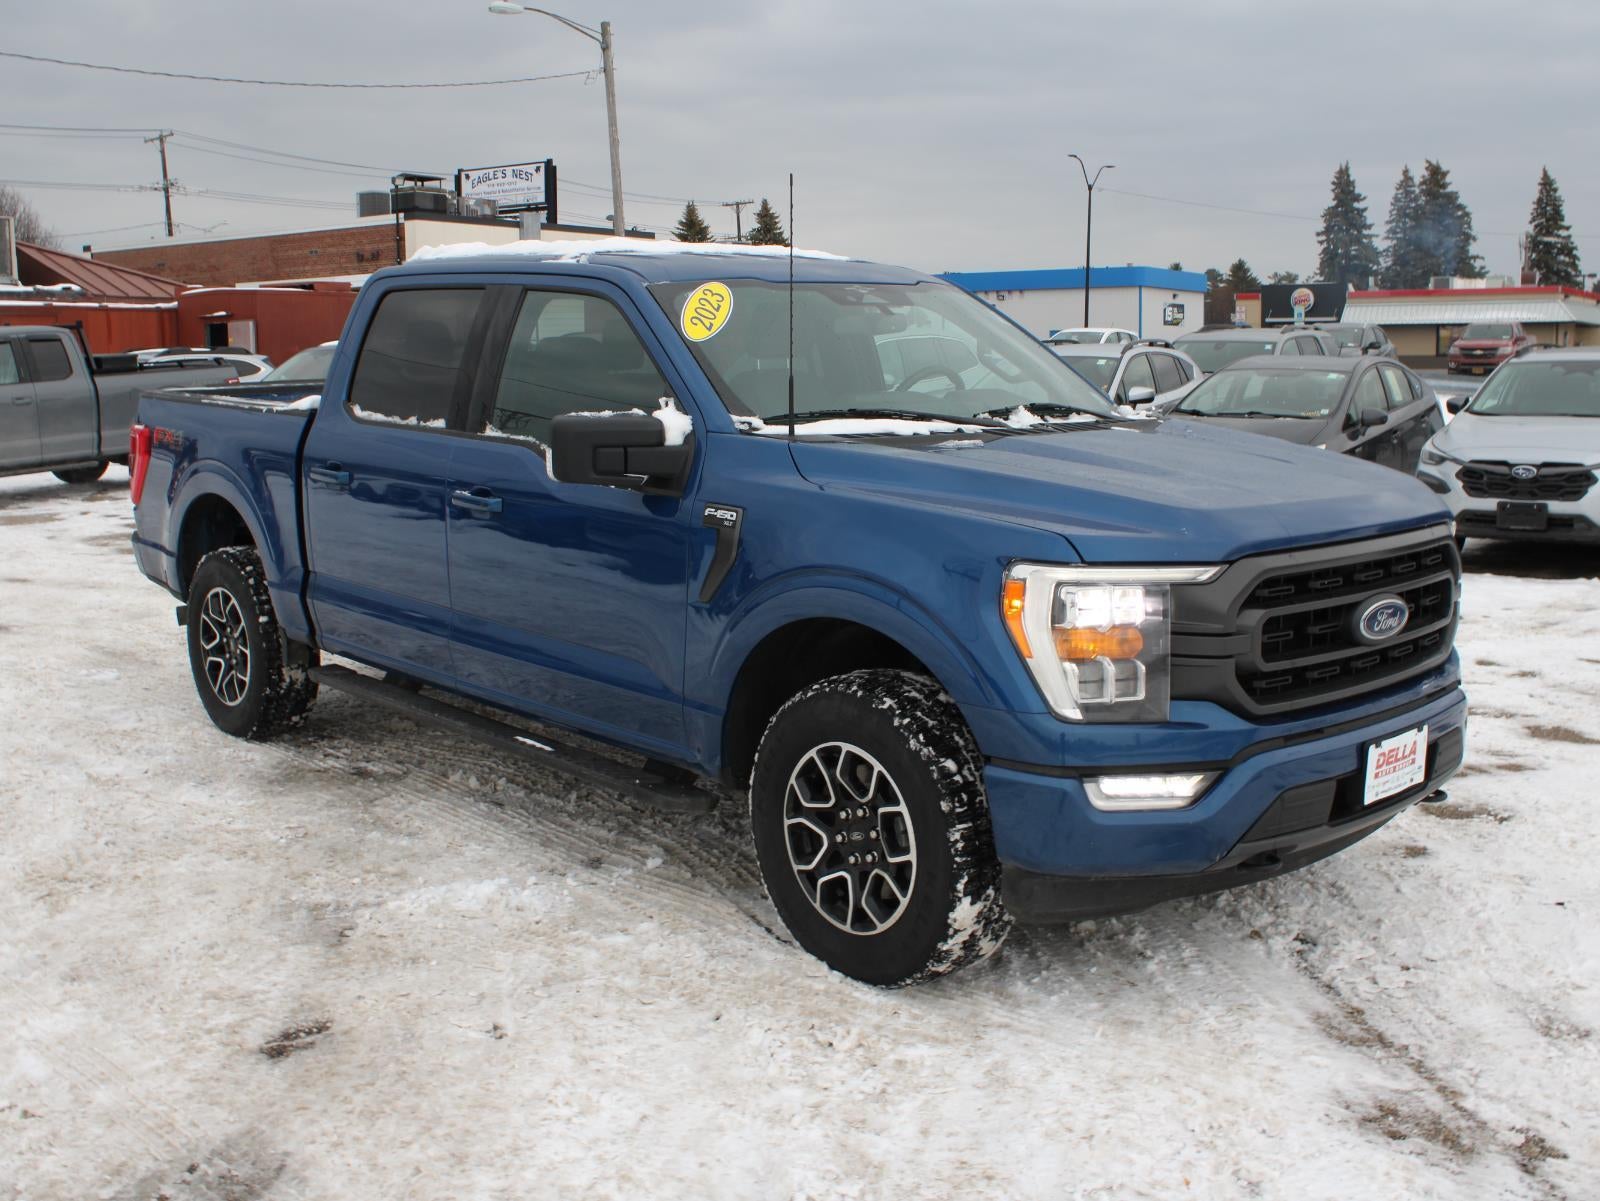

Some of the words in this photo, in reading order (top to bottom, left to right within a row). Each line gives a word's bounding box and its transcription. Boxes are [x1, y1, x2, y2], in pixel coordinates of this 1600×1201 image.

[471, 169, 507, 189] EAGLE'S
[512, 168, 533, 182] NEST
[690, 288, 725, 332] 2023
[704, 508, 737, 521] F-150
[1375, 608, 1400, 631] Ford
[1376, 740, 1417, 769] DELLA
